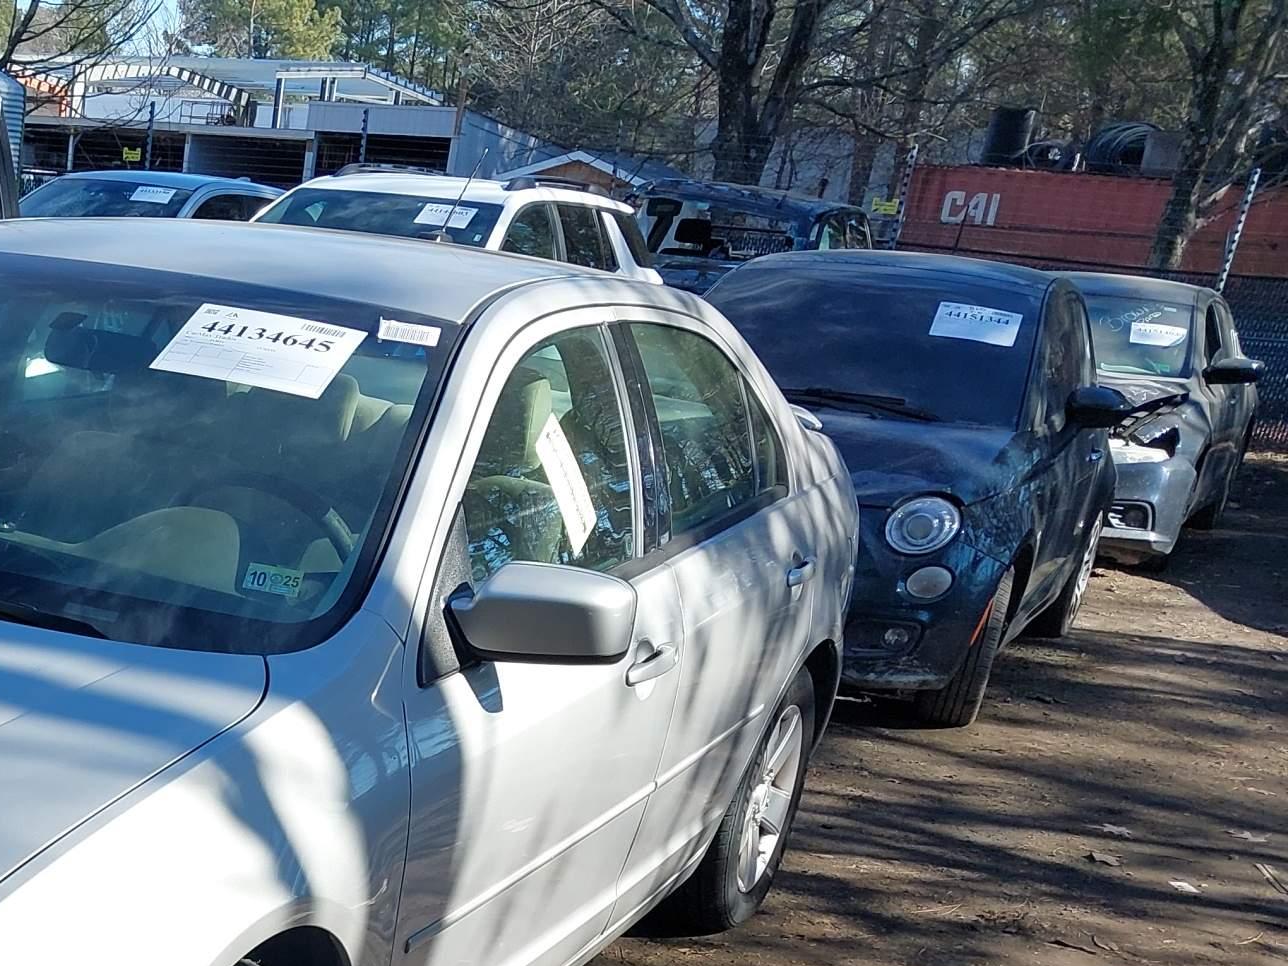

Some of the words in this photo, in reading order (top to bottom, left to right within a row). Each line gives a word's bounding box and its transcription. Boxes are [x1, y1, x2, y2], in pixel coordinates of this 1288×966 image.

[940, 190, 1001, 226] CAI
[201, 321, 335, 353] 44134645
[250, 570, 267, 587] 10
[282, 575, 300, 588] 25
